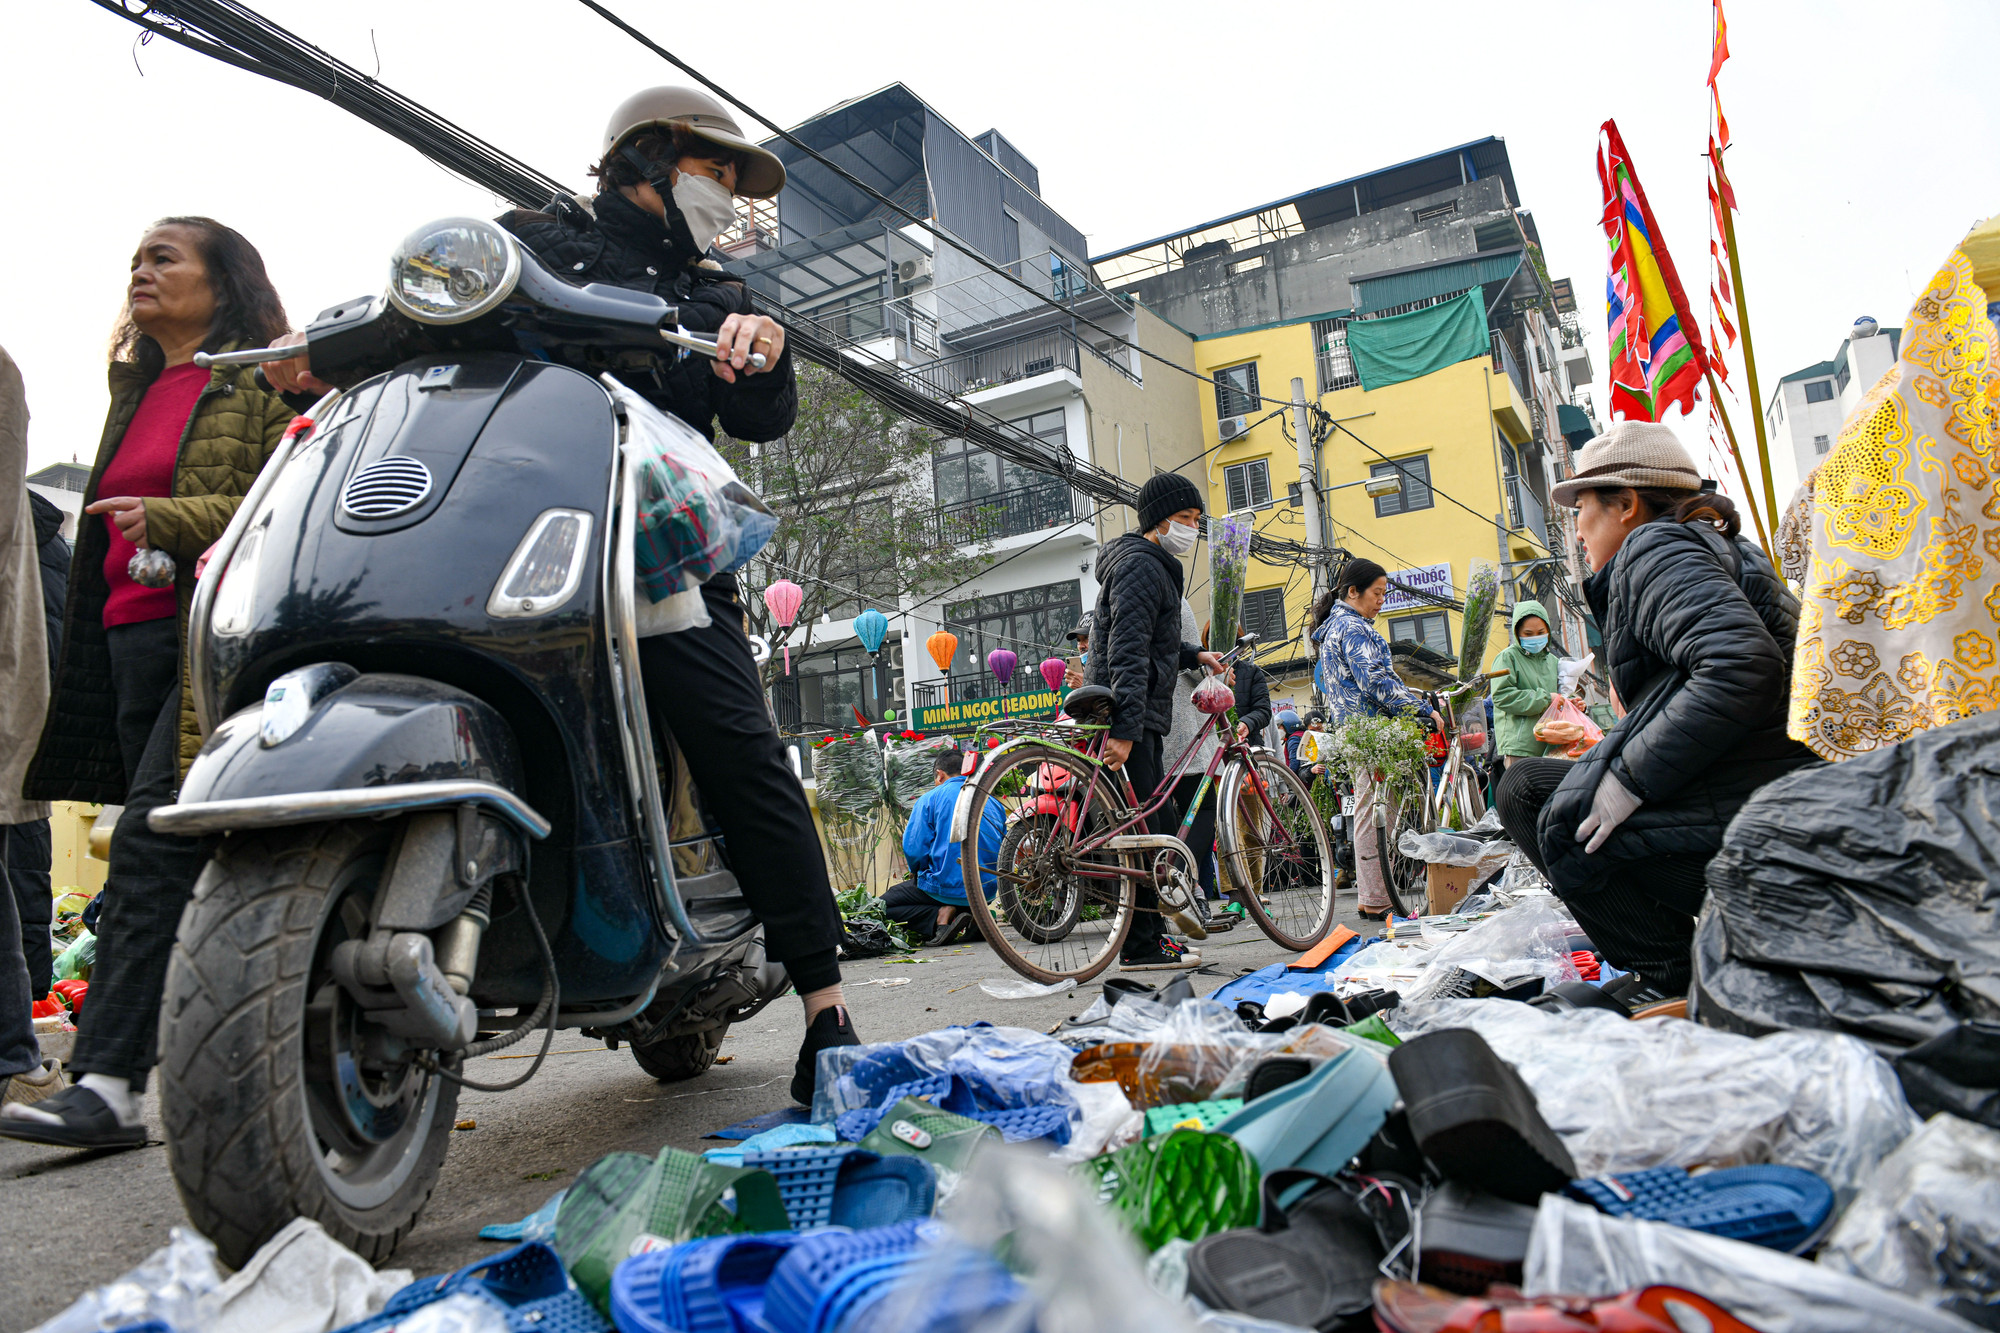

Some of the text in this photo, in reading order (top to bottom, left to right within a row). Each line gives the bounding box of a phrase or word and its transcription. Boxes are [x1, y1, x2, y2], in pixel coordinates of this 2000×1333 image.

[1406, 566, 1446, 586] THUỐC
[923, 691, 1063, 725] MINH NGỌC BEADING
